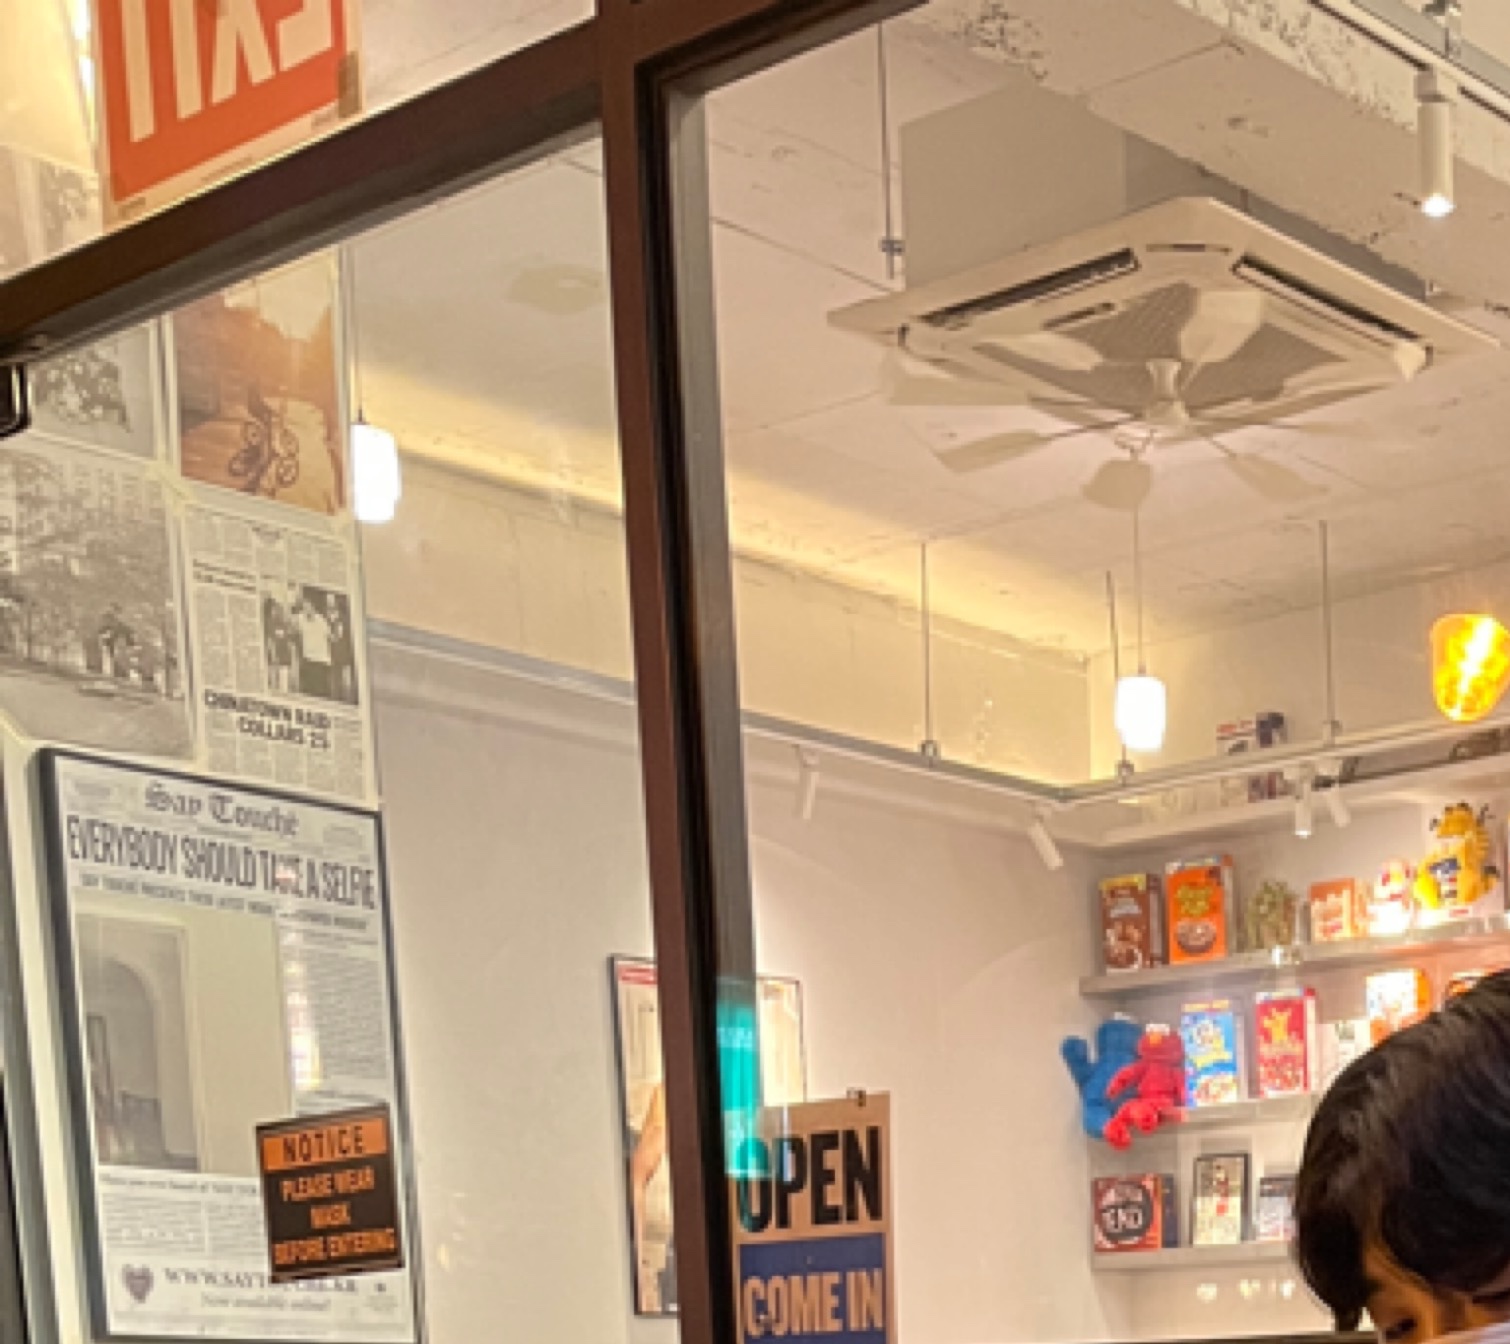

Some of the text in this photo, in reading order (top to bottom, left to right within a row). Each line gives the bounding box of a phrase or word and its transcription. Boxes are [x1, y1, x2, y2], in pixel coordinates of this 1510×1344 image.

[68, 815, 177, 874] EVERYBODY
[180, 834, 256, 887] SHOULD
[305, 857, 320, 899] A
[321, 861, 376, 911] SELFIE
[282, 1125, 364, 1162] NOTICE
[279, 1171, 333, 1202] PLEASE
[334, 1165, 375, 1194] WEAR
[735, 1125, 883, 1233] OPEN
[310, 1202, 351, 1229] MASK
[274, 1228, 395, 1265] BEFORE ENTERING
[743, 1267, 883, 1338] COME IN
